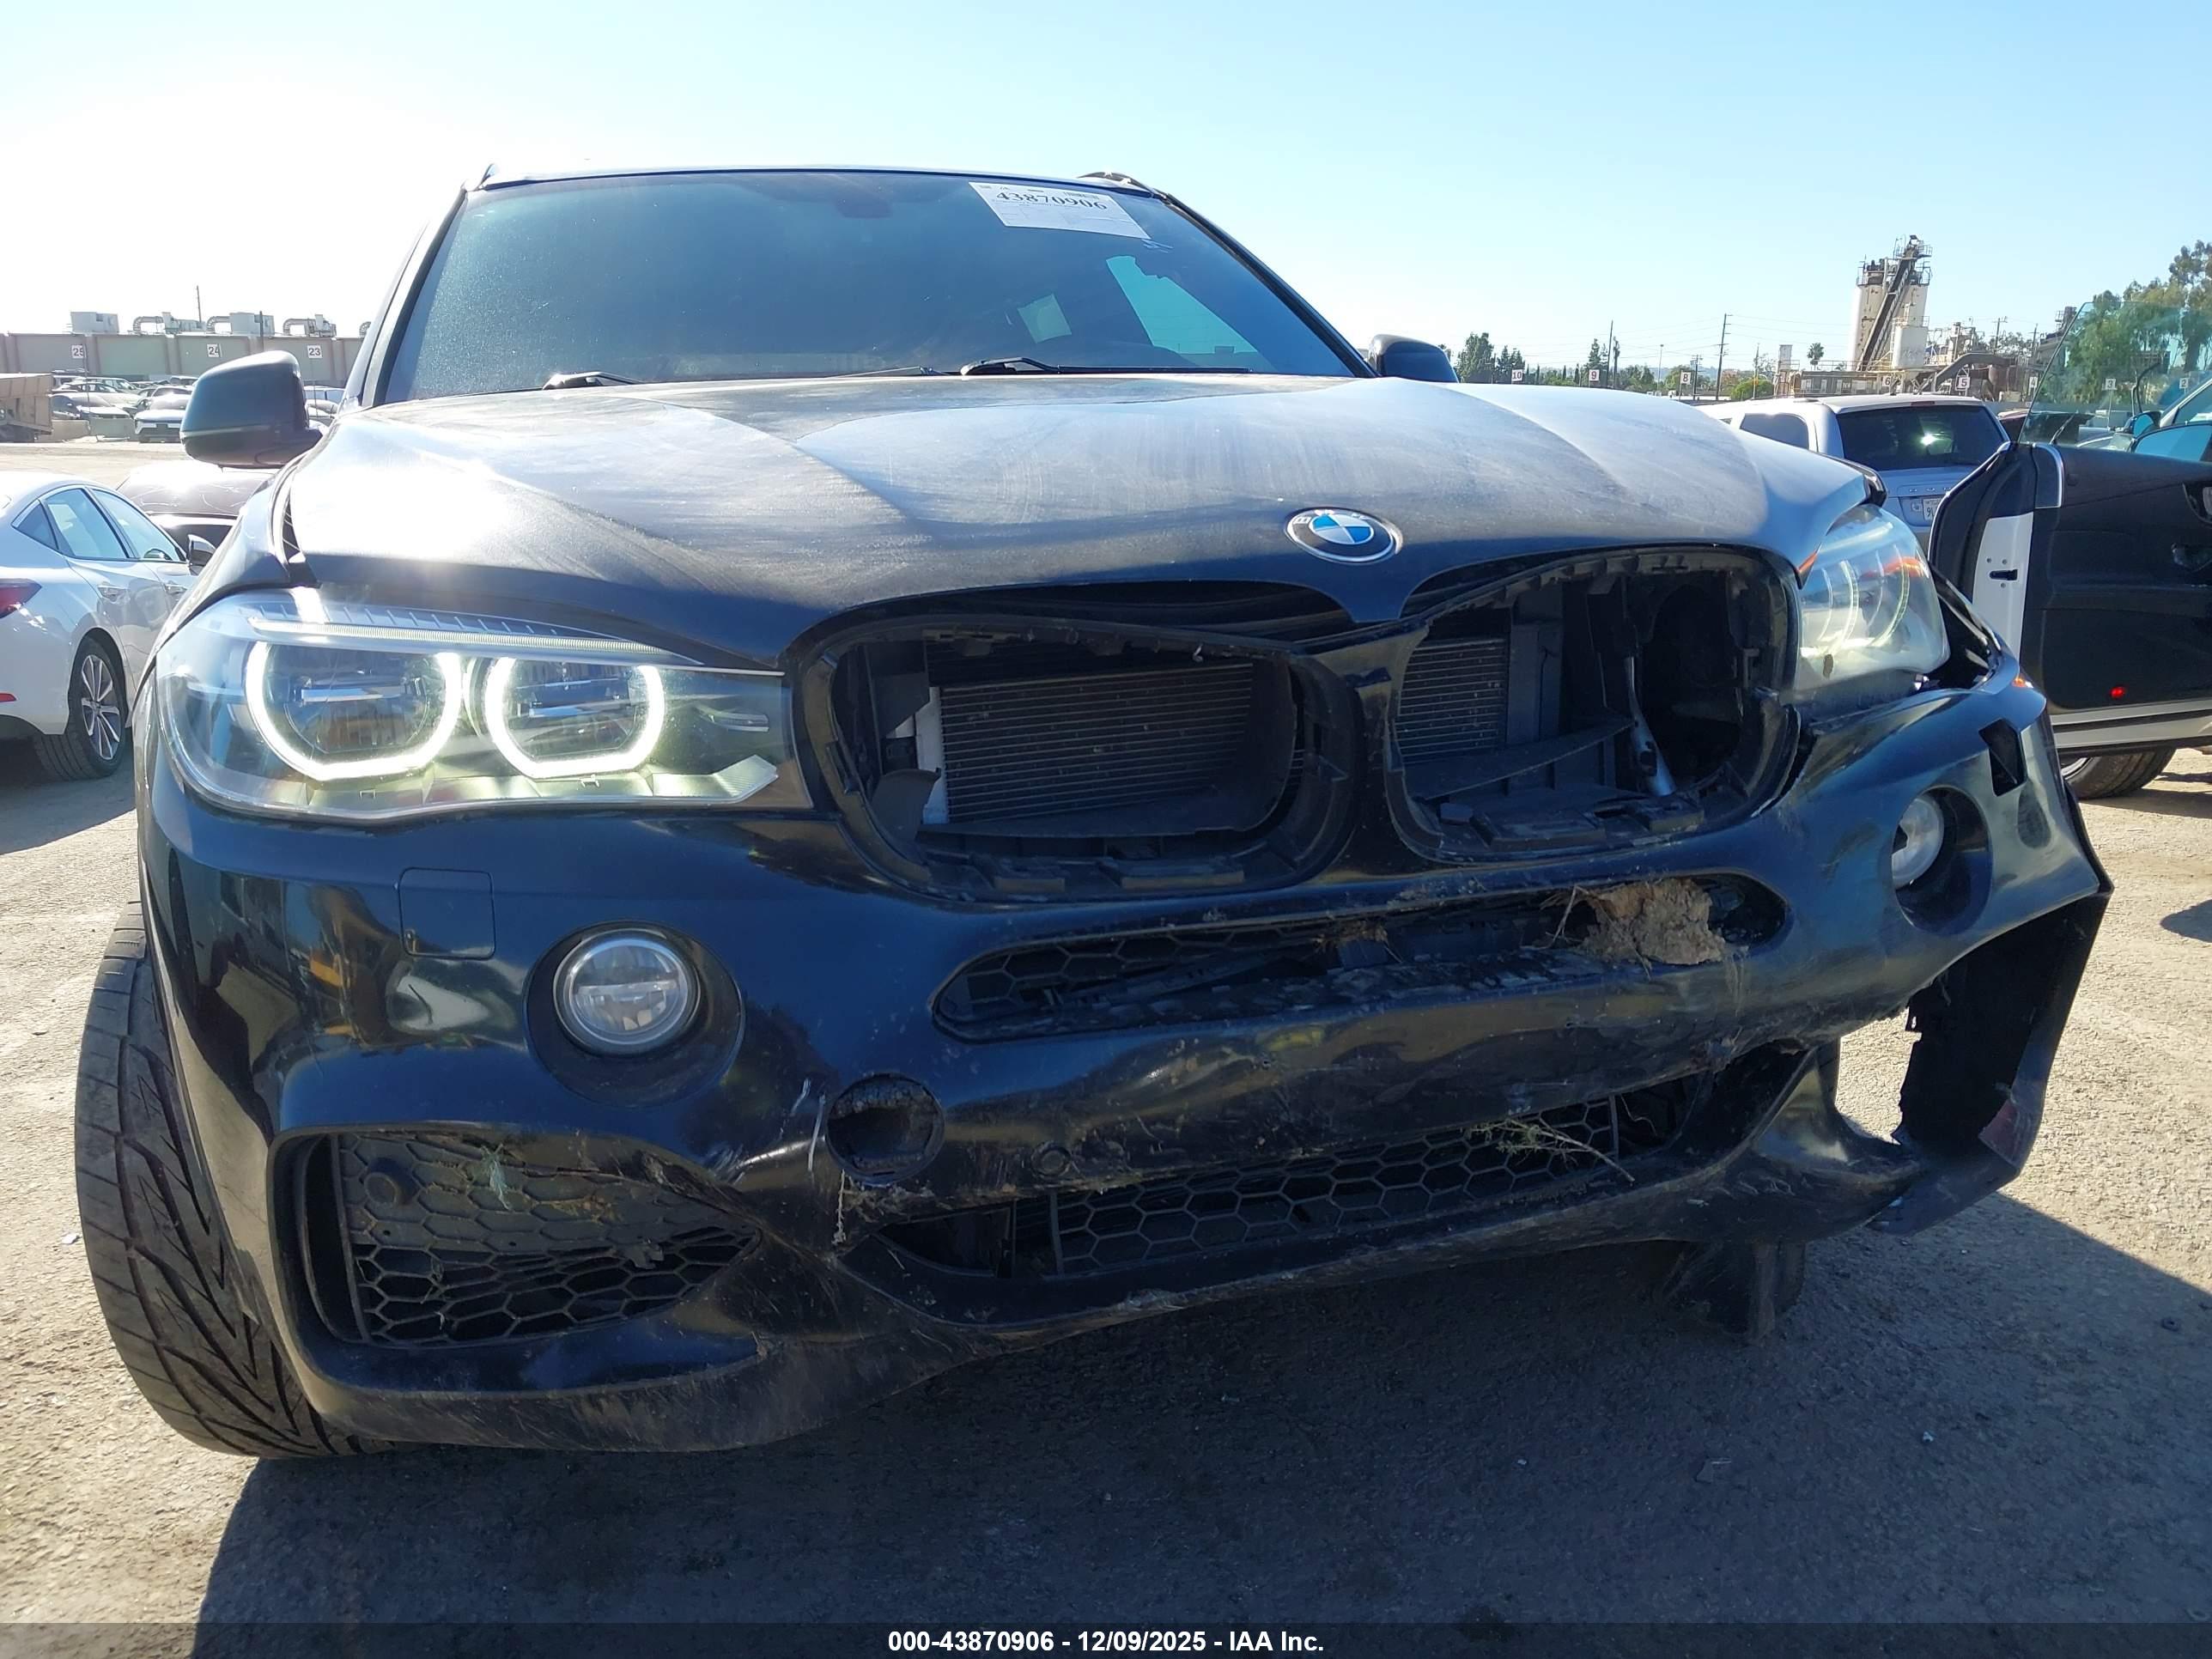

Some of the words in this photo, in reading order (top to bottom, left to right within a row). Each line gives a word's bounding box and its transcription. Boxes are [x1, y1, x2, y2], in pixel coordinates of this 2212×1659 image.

[996, 191, 1108, 210] 43870906
[309, 348, 320, 356] 23
[1591, 371, 1596, 380] 9
[1961, 378, 1967, 386] 5
